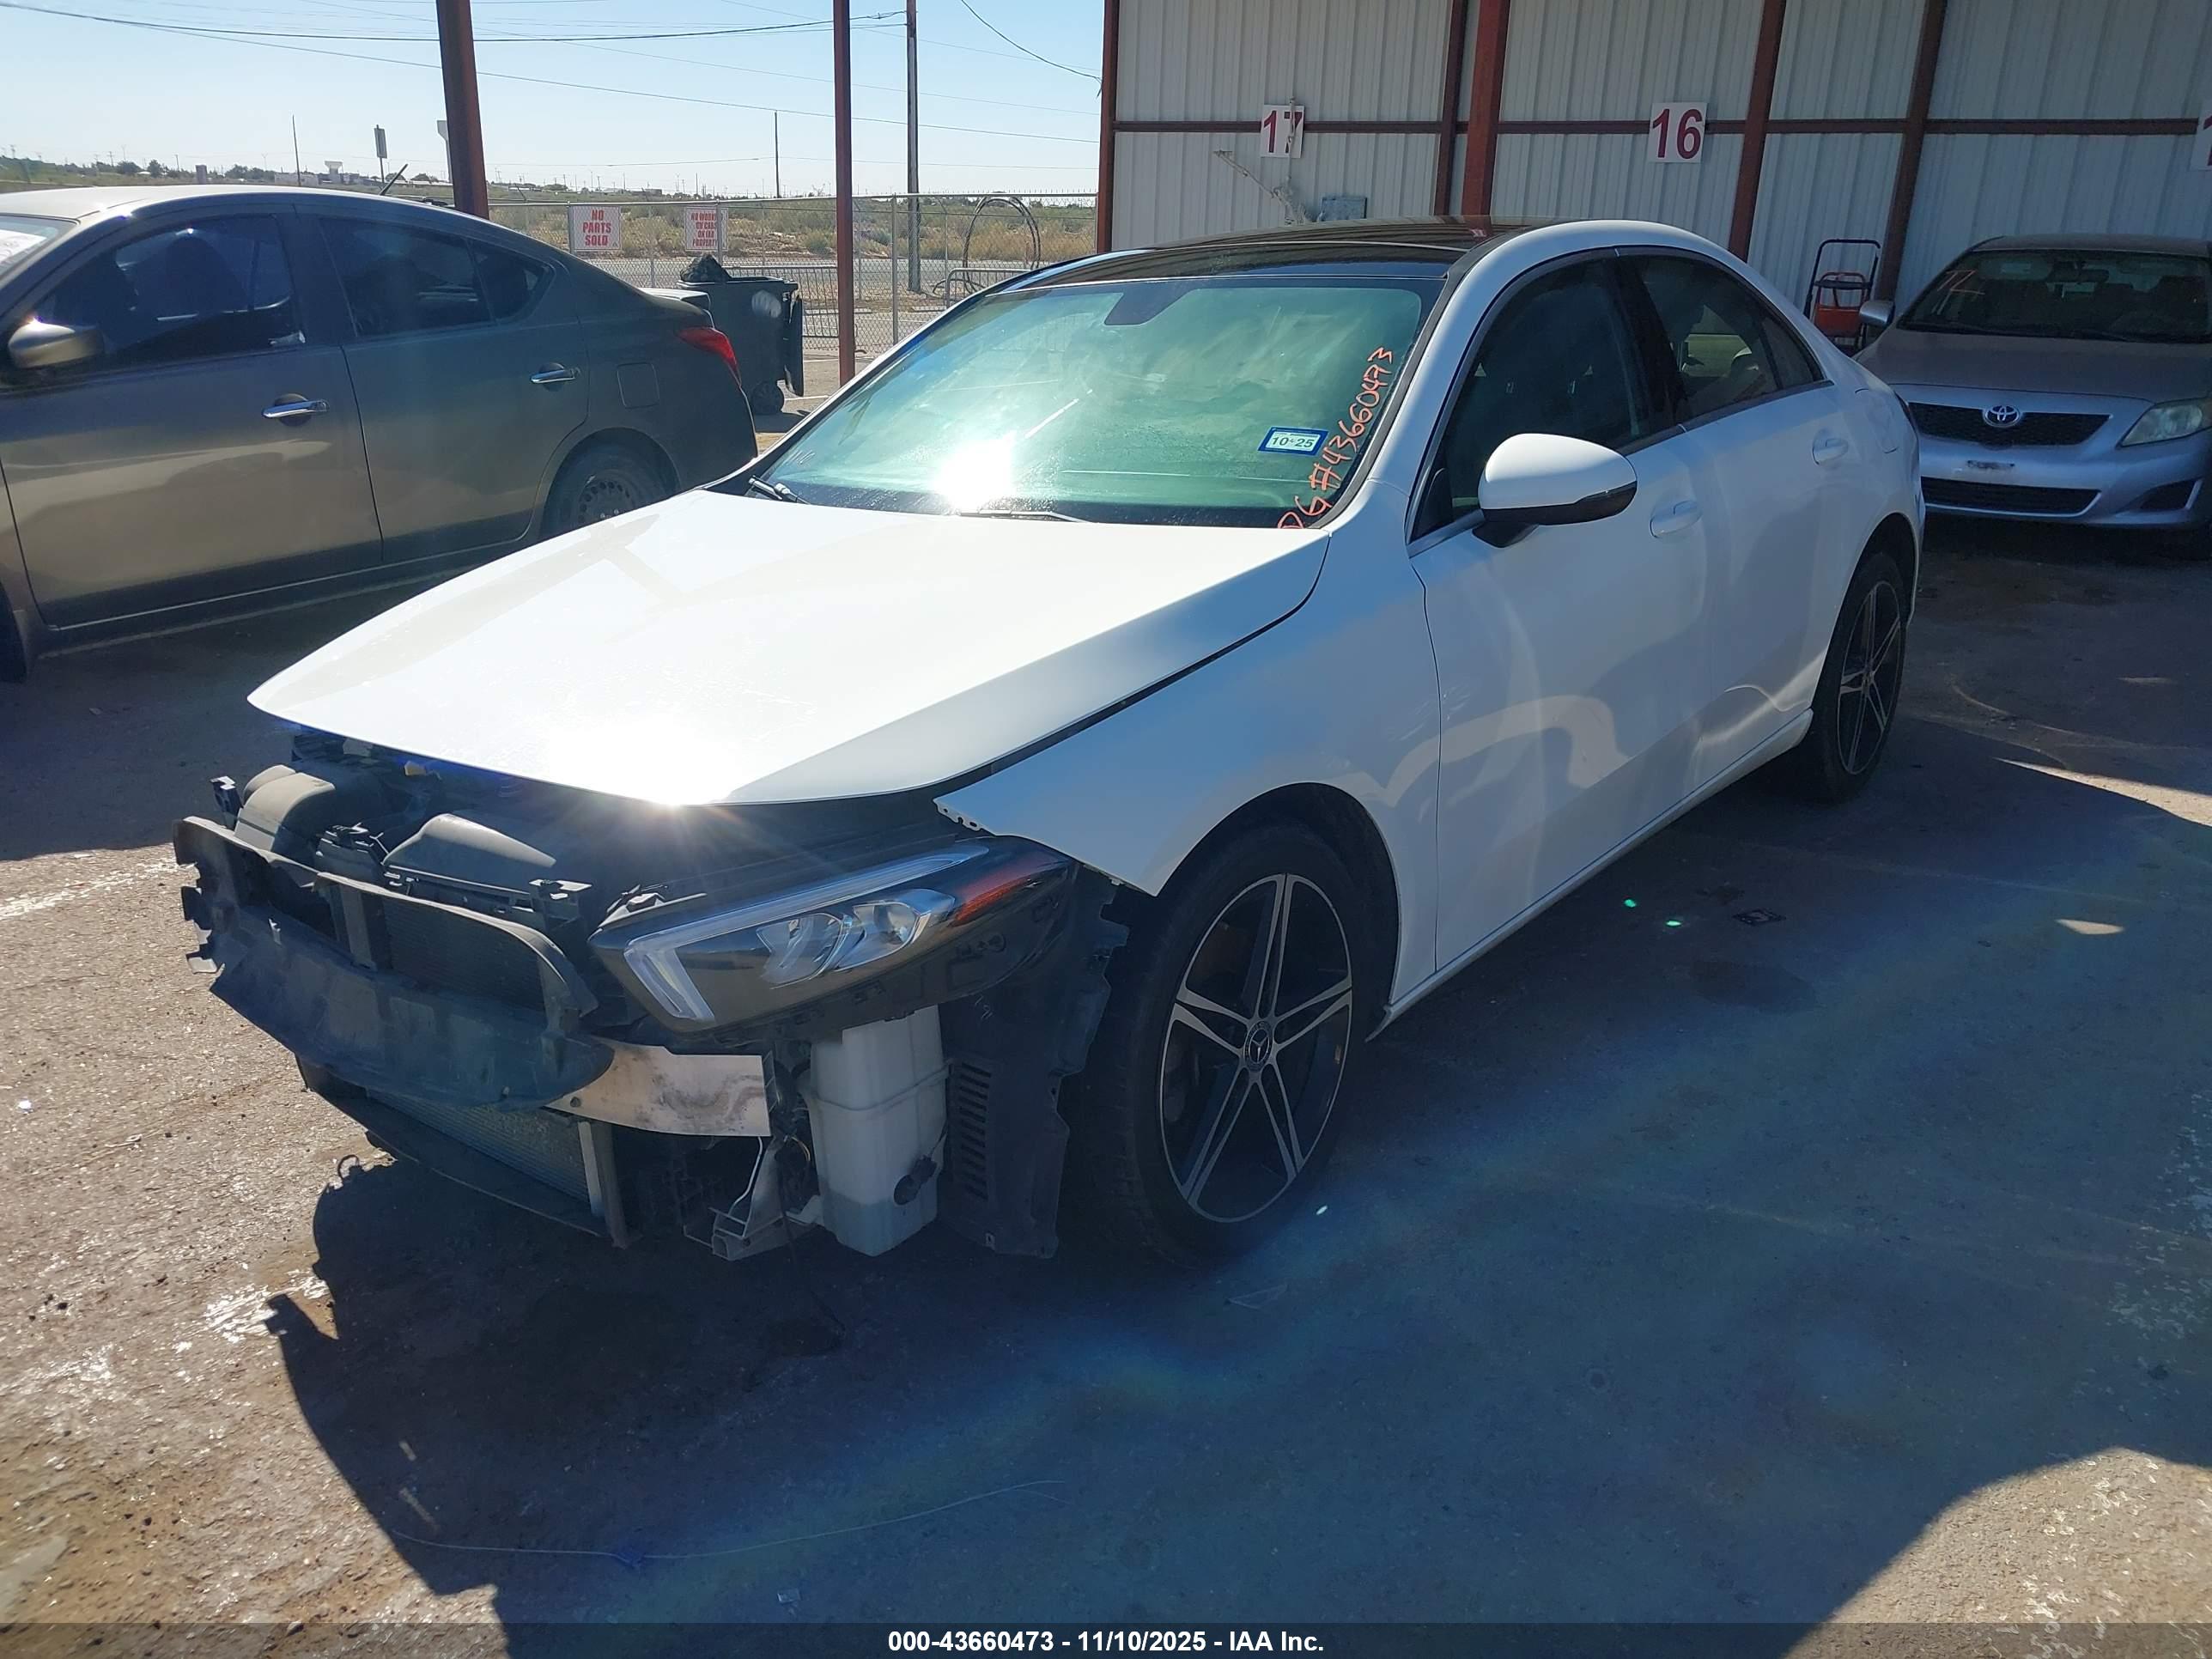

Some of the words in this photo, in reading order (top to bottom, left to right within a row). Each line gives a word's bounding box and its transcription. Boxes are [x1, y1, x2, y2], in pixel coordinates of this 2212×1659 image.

[1264, 110, 1303, 153] 17
[1652, 108, 1703, 159] 16
[591, 210, 605, 221] NO
[690, 212, 699, 221] NO
[582, 222, 611, 234] PARTS
[585, 234, 608, 246] SOLD
